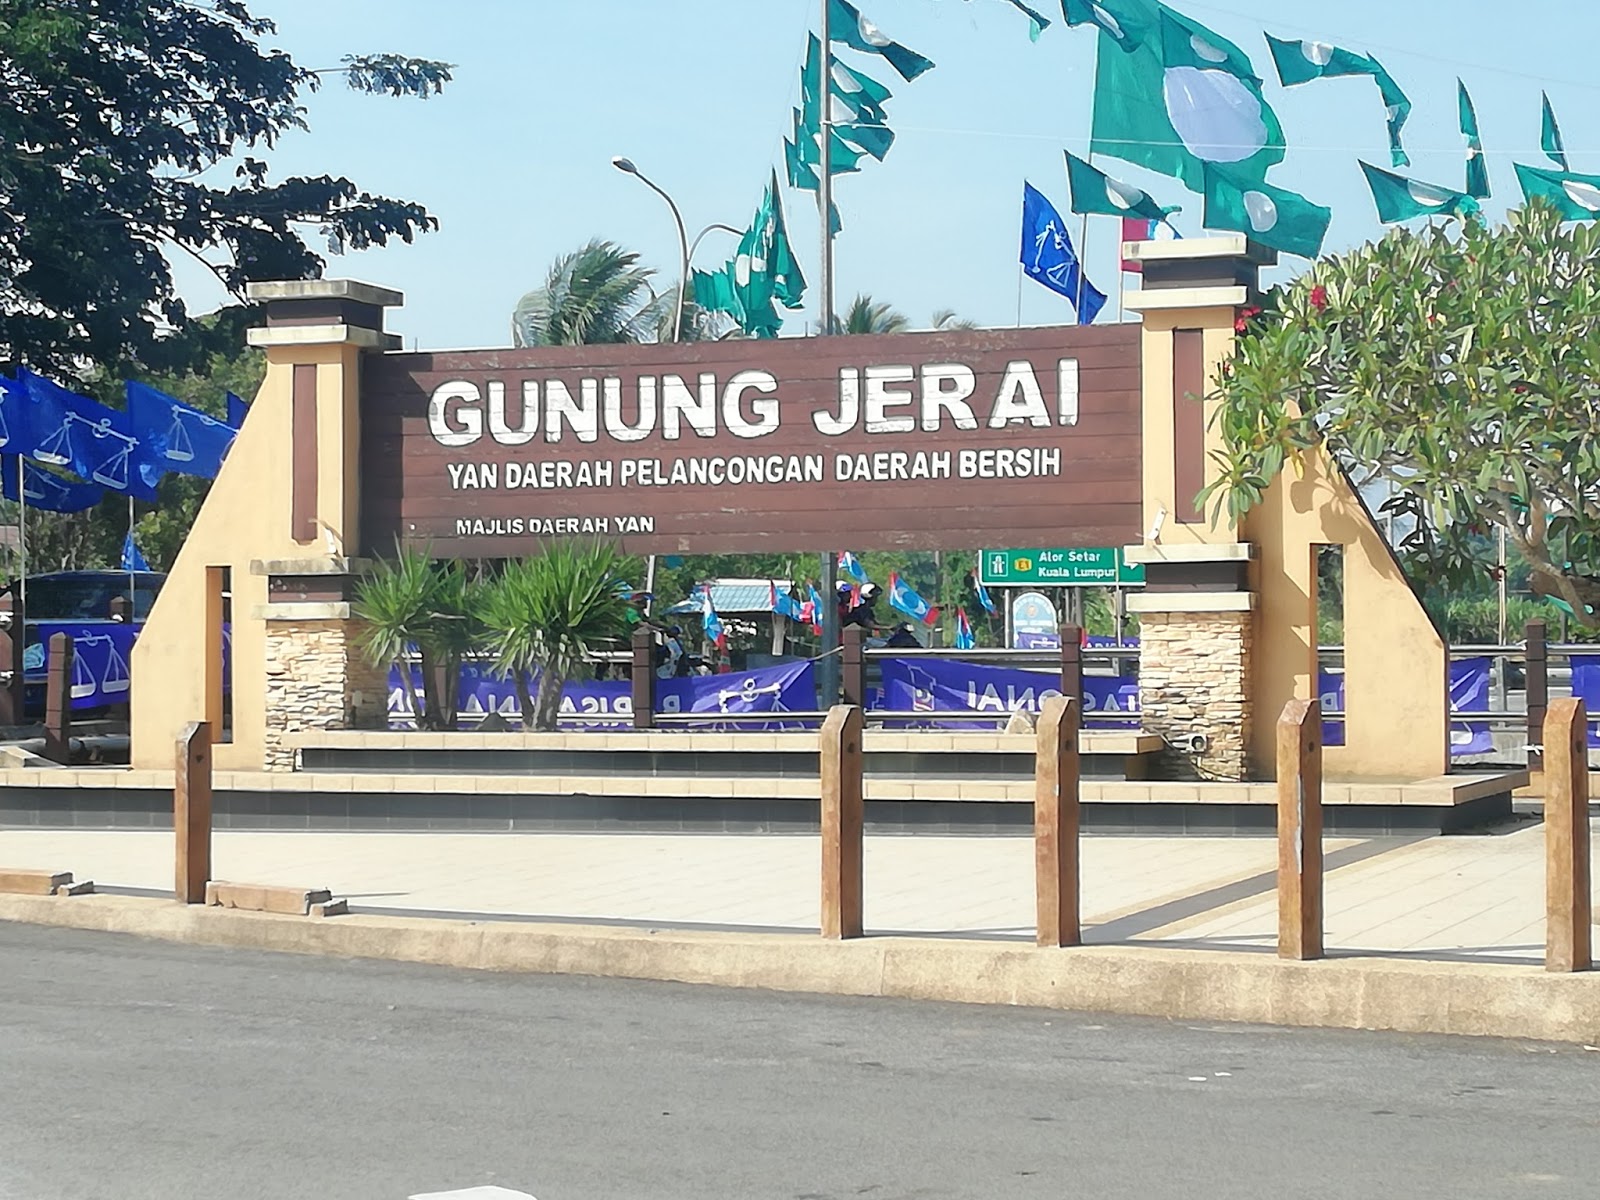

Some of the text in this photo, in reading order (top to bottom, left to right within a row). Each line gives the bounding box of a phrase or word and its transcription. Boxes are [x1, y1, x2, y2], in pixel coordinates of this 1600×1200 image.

[427, 358, 1079, 447] GUNUNG JERAI
[447, 447, 1060, 490] YAN DAERAH PELANCONGAN DAERAH BERSIH
[456, 516, 654, 535] MAJLIS DAERAH YAN
[1038, 551, 1101, 562] Alor Setar
[1038, 566, 1116, 579] Kuala Lumpur
